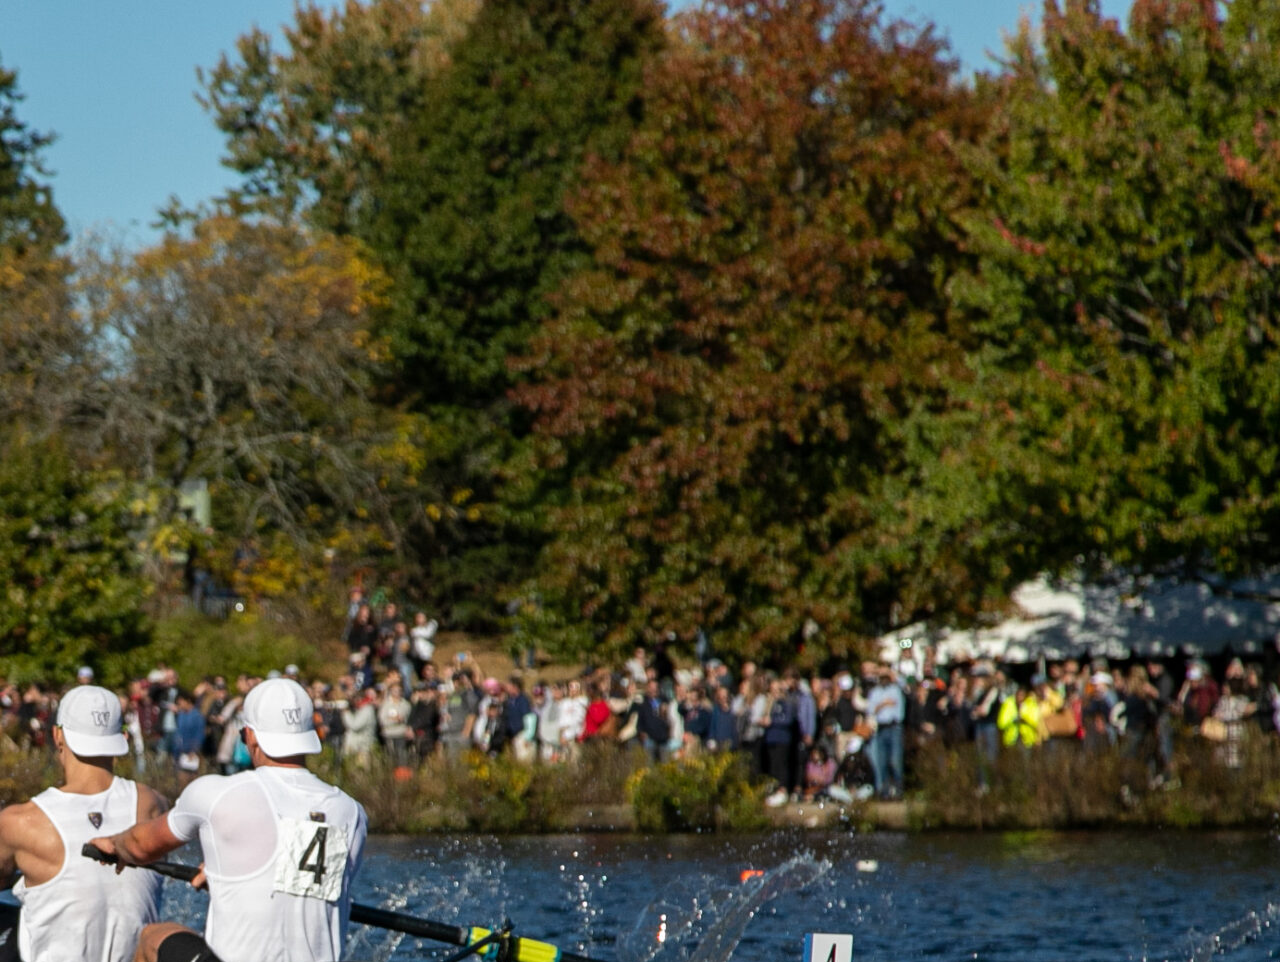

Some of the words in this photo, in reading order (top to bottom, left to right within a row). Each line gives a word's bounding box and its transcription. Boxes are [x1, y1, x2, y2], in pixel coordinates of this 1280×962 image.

[91, 711, 111, 727] W
[282, 708, 302, 725] W
[298, 826, 329, 885] 4
